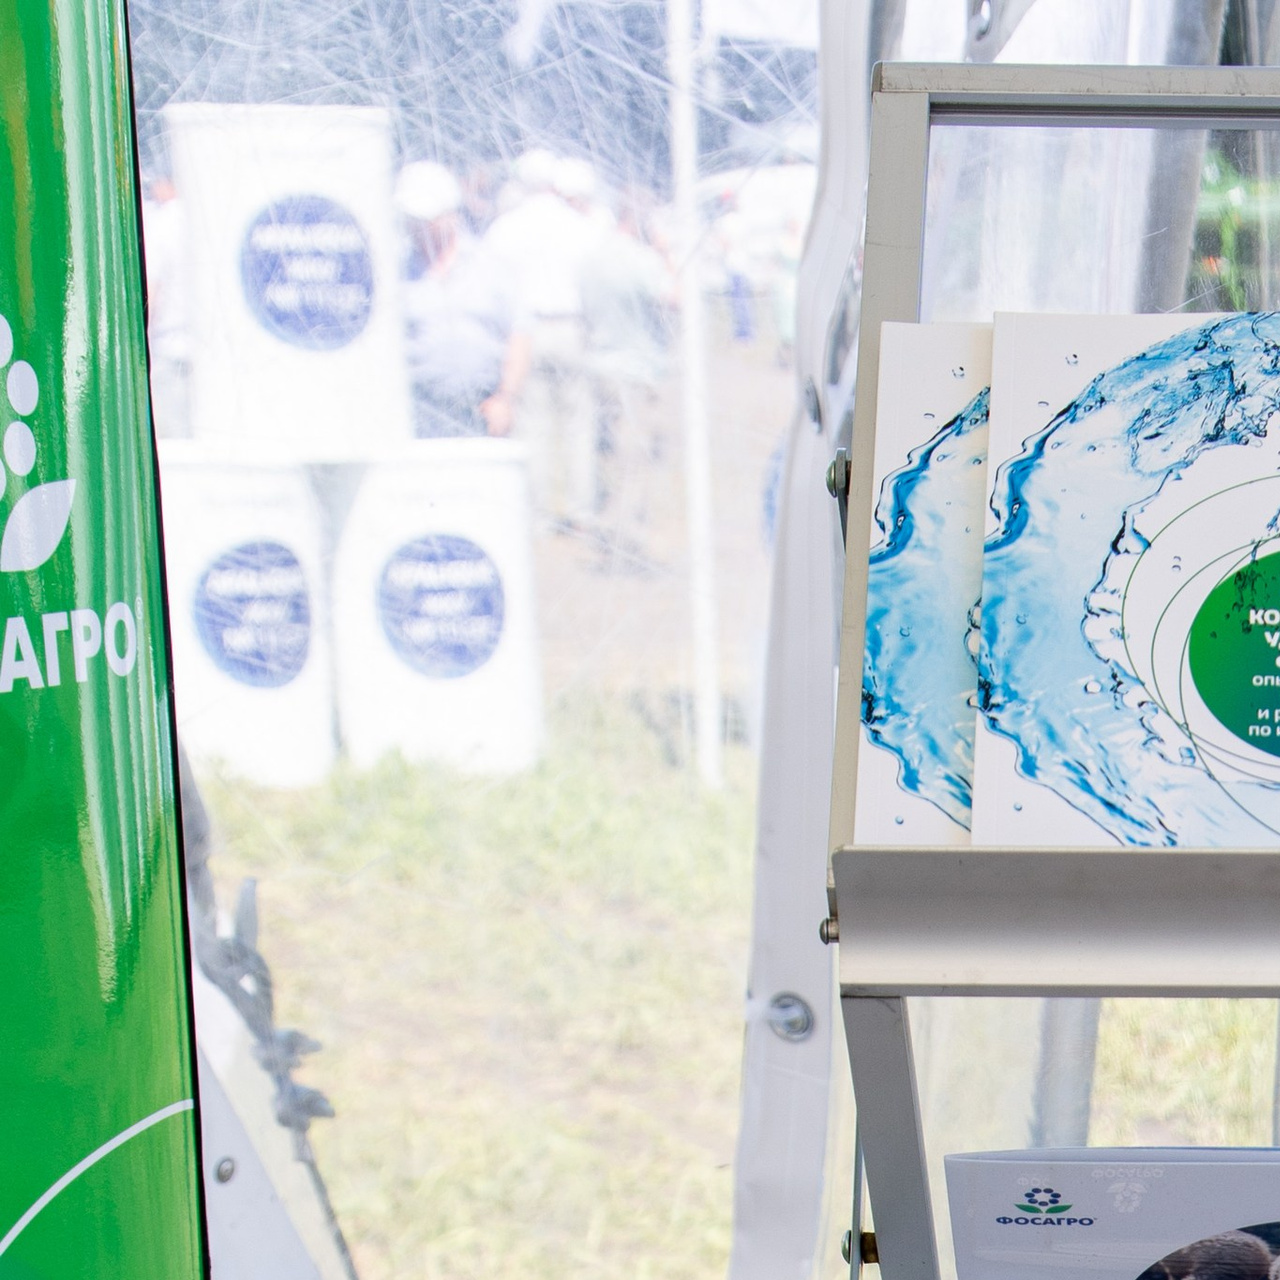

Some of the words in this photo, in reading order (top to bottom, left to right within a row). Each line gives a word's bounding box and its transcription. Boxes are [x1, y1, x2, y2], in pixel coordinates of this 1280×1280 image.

[0, 601, 137, 693] АГРО
[1257, 708, 1270, 720] и
[1249, 725, 1271, 737] по
[996, 1216, 1094, 1226] ФОСАГРО
